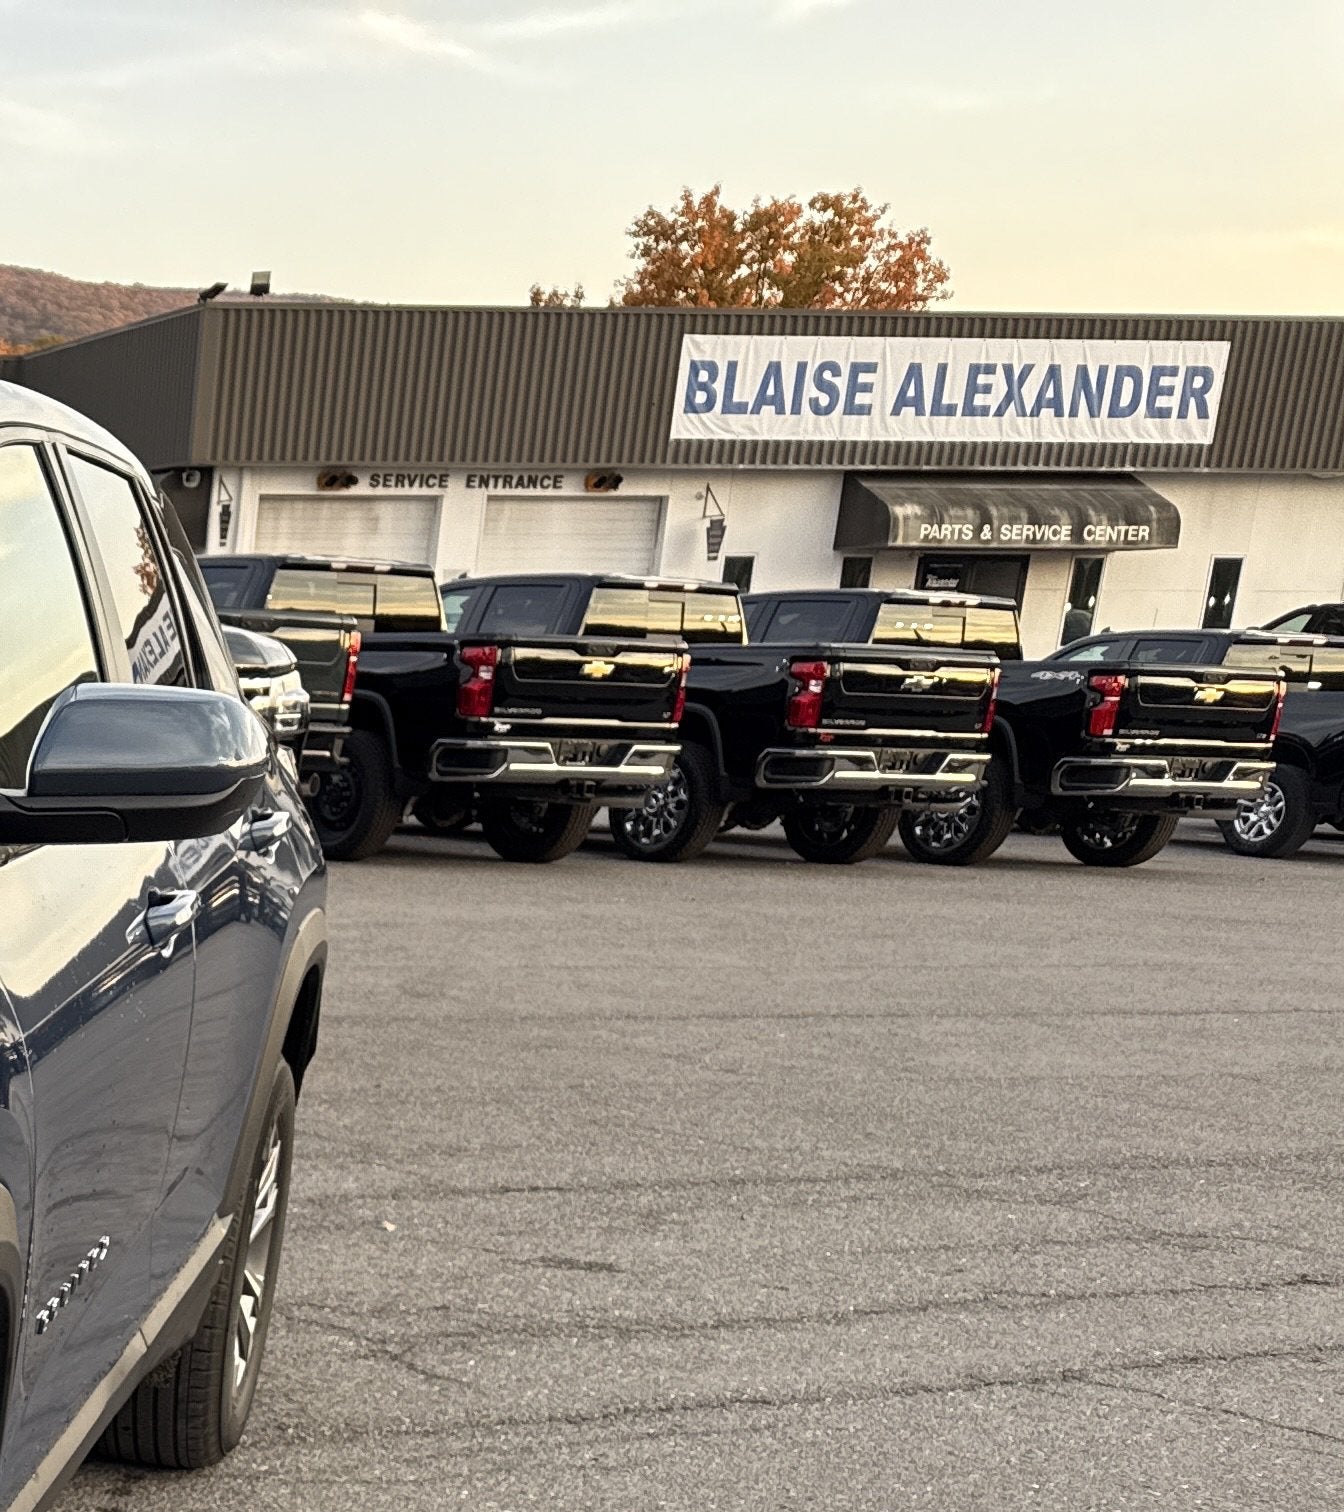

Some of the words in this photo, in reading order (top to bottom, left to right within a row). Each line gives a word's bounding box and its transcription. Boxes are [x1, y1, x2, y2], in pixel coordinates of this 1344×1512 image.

[683, 360, 877, 416] BLAISE
[890, 363, 1214, 419] ALEXANDER
[369, 473, 450, 488] SERVICE
[465, 474, 565, 489] ENTRANCE
[920, 524, 973, 540] PARTS
[980, 524, 992, 540] &
[1000, 525, 1072, 541] SERVICE
[1083, 525, 1149, 541] CENTER
